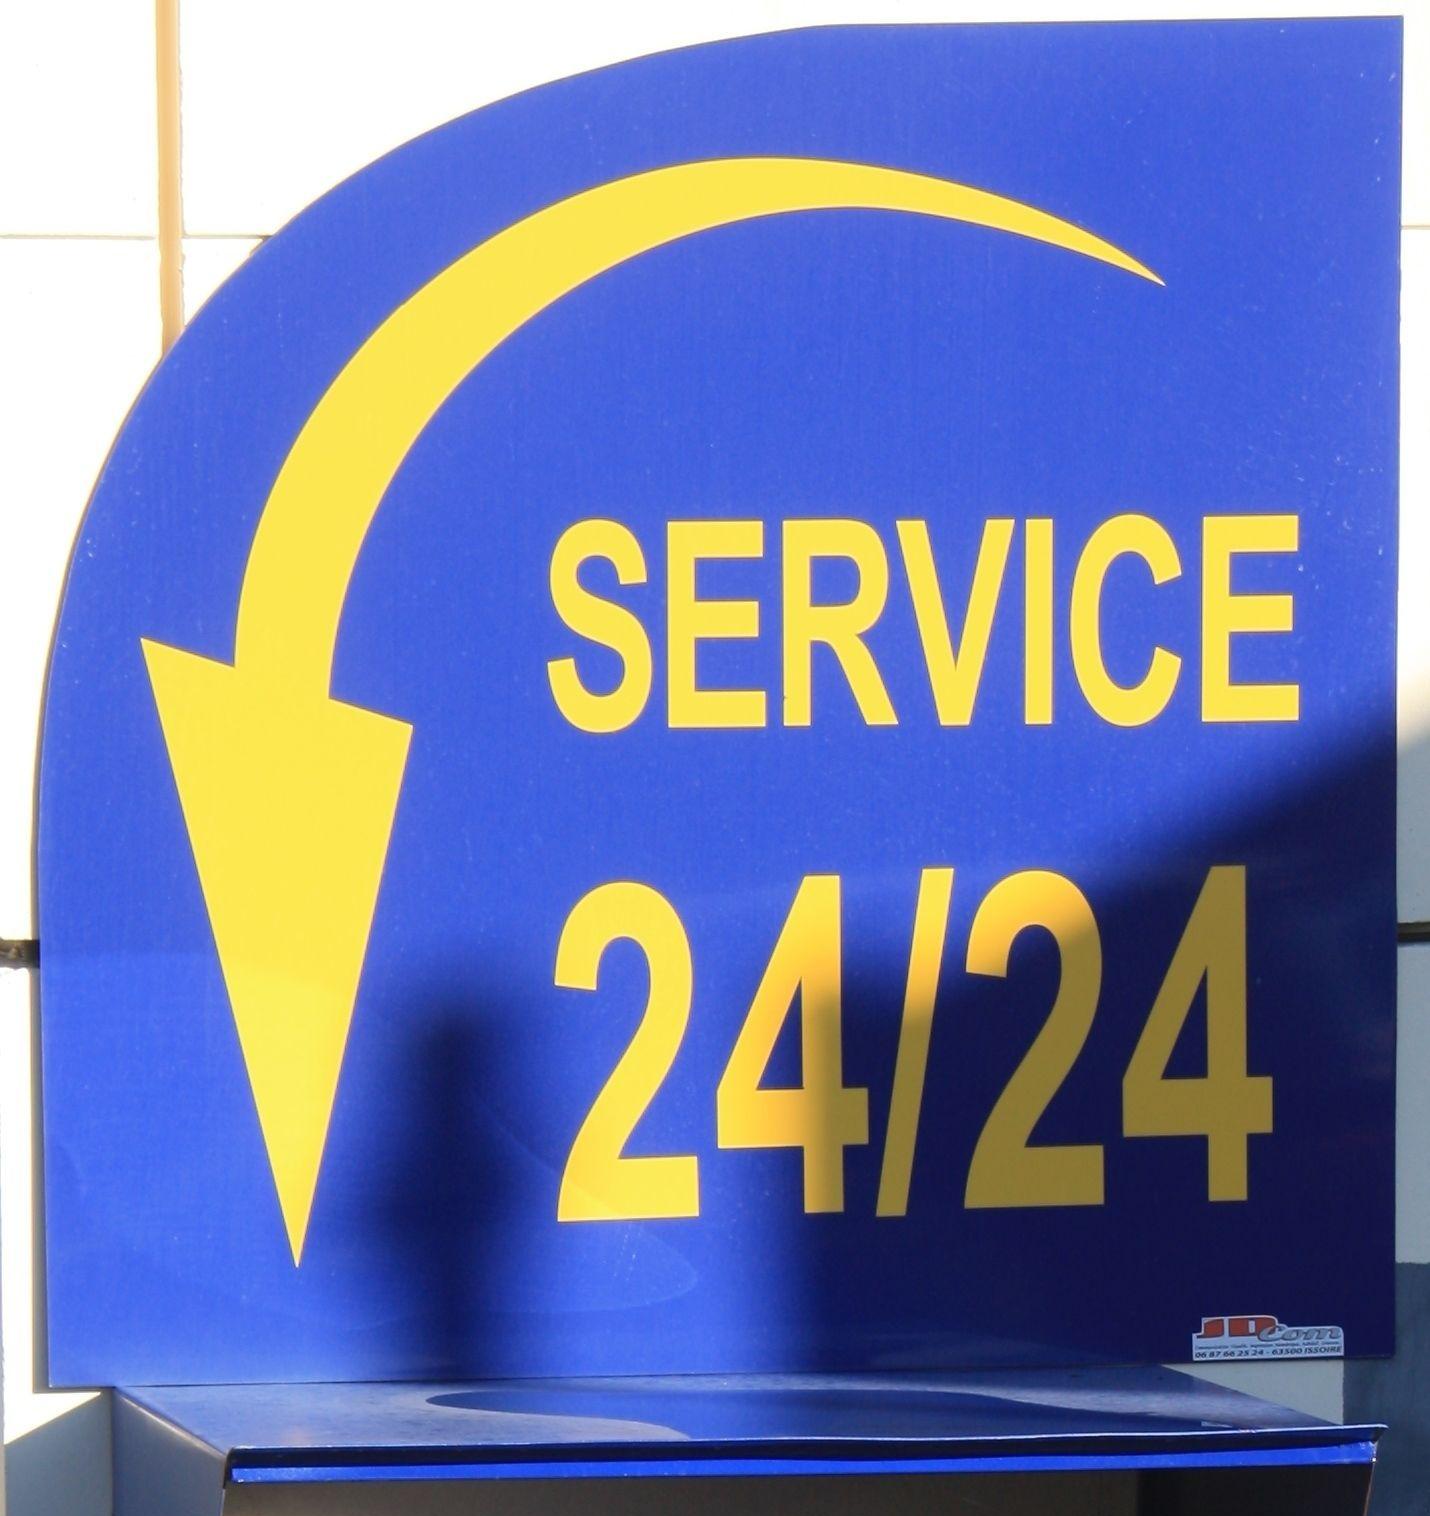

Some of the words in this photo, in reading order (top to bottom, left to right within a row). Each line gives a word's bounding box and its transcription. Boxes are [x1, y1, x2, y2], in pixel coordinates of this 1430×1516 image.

[547, 513, 1300, 733] SERVICE
[554, 865, 1274, 1223] 24/24
[1304, 1346, 1342, 1354] ISSOIRE
